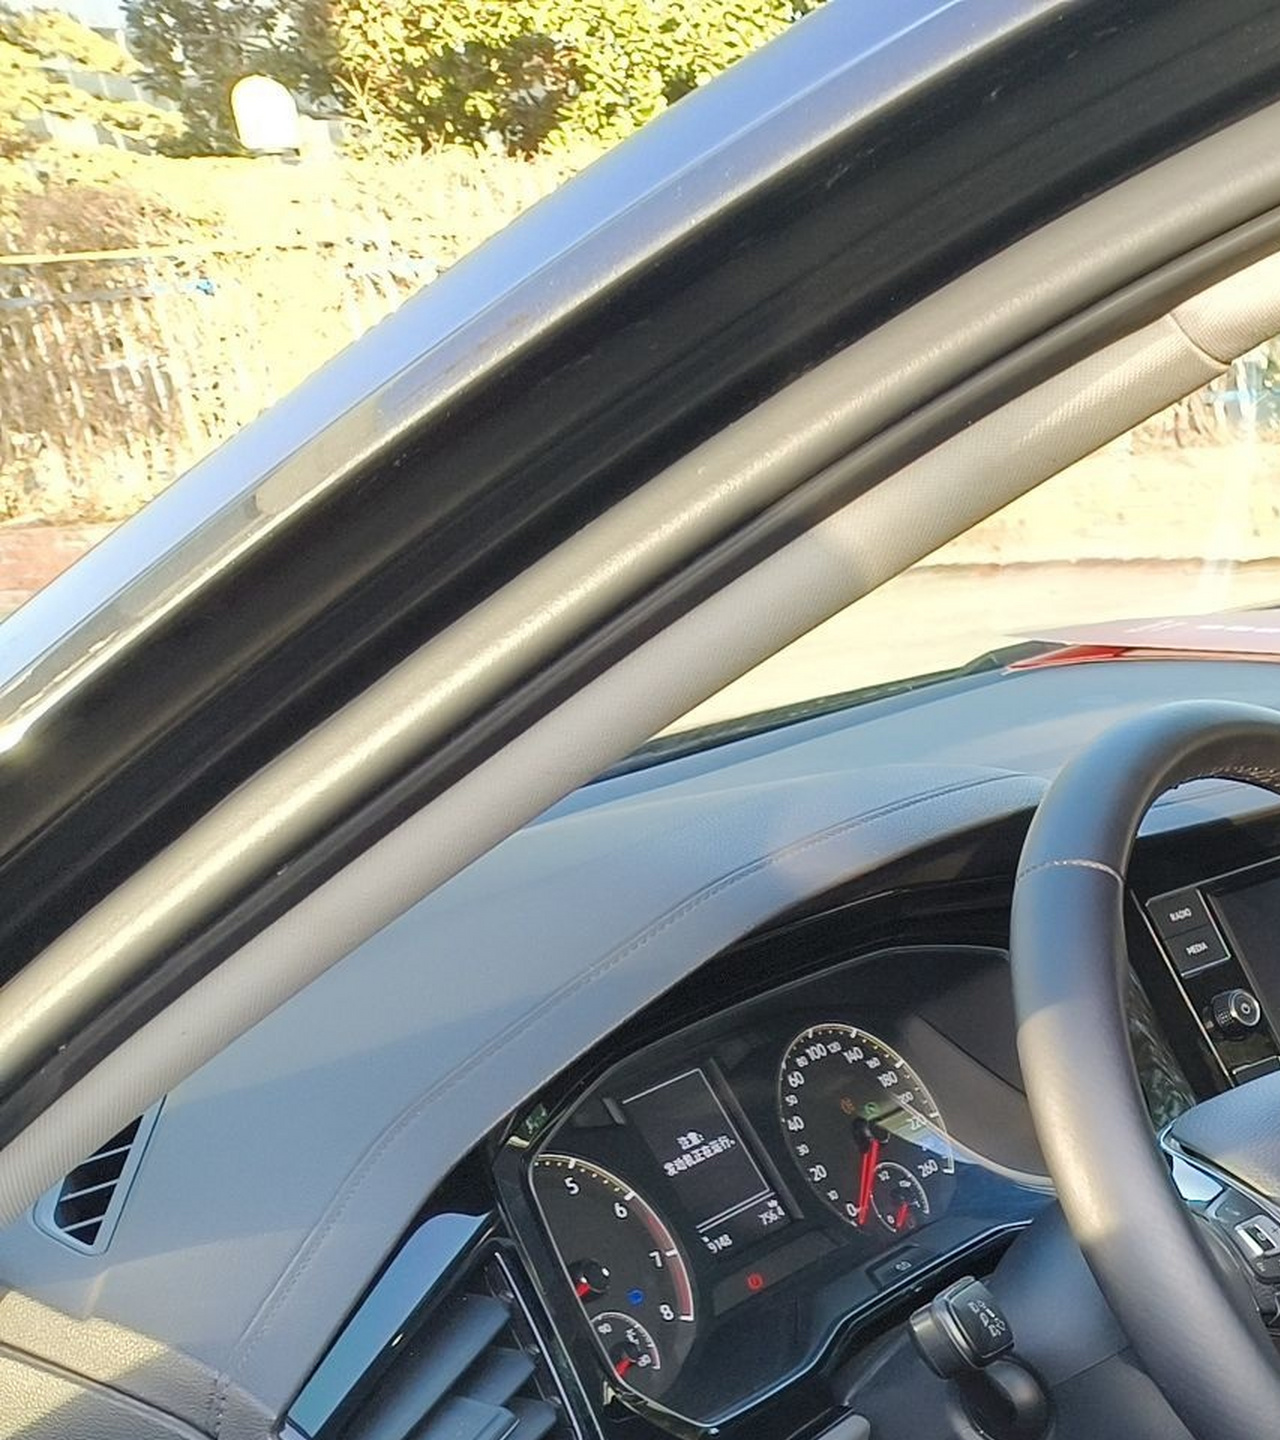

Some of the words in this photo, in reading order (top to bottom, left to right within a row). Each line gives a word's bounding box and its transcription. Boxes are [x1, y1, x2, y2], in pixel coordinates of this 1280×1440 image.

[805, 1043, 827, 1061] 100
[843, 1047, 864, 1063] 140
[787, 1071, 804, 1088] 60
[877, 1070, 898, 1088] 180
[787, 1116, 804, 1132] 40
[809, 1164, 827, 1181] 20
[918, 1159, 938, 1178] 260
[564, 1176, 579, 1194] 5
[614, 1202, 628, 1219] 6
[845, 1203, 858, 1217] 0
[649, 1250, 663, 1267] 7
[659, 1304, 674, 1321] 8
